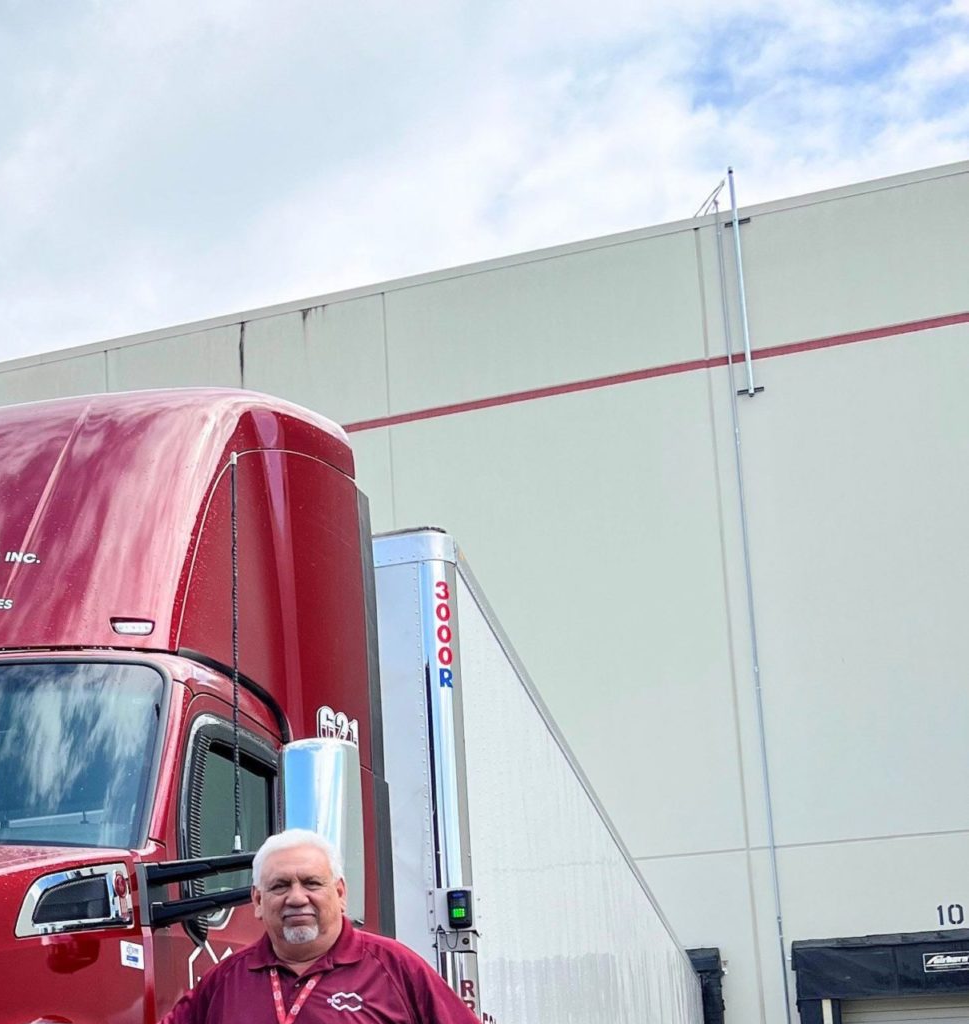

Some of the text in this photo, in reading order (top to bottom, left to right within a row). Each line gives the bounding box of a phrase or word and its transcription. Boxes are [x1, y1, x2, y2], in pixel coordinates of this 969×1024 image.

[4, 551, 41, 565] INC.
[435, 581, 453, 688] 3000R
[936, 904, 965, 926] 10
